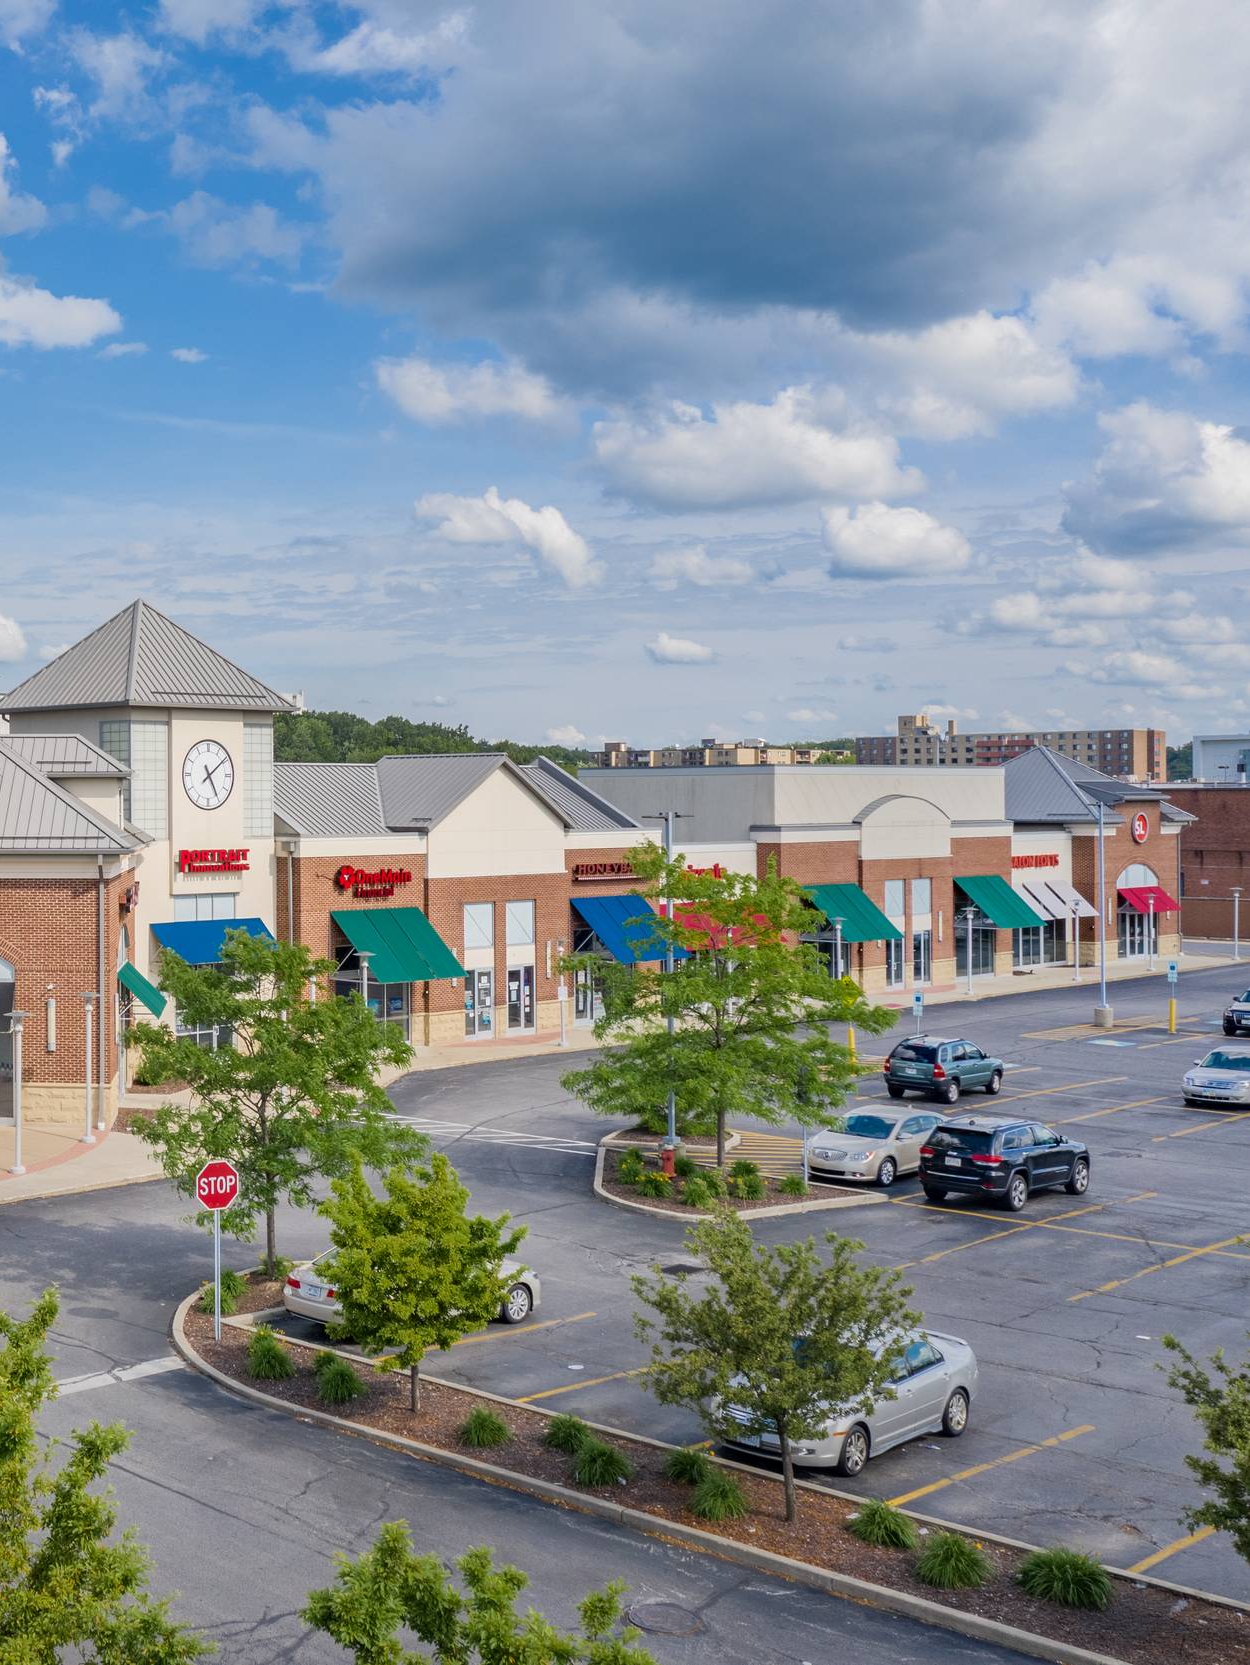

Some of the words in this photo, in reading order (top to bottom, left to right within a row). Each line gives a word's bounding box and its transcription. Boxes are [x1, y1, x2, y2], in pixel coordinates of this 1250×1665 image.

[179, 849, 250, 872] PORTRAIT
[1012, 855, 1035, 868] ALON
[578, 863, 630, 875] HONEYB
[355, 869, 412, 884] OneMain
[355, 886, 394, 898] Financial
[200, 1175, 235, 1196] STOP
